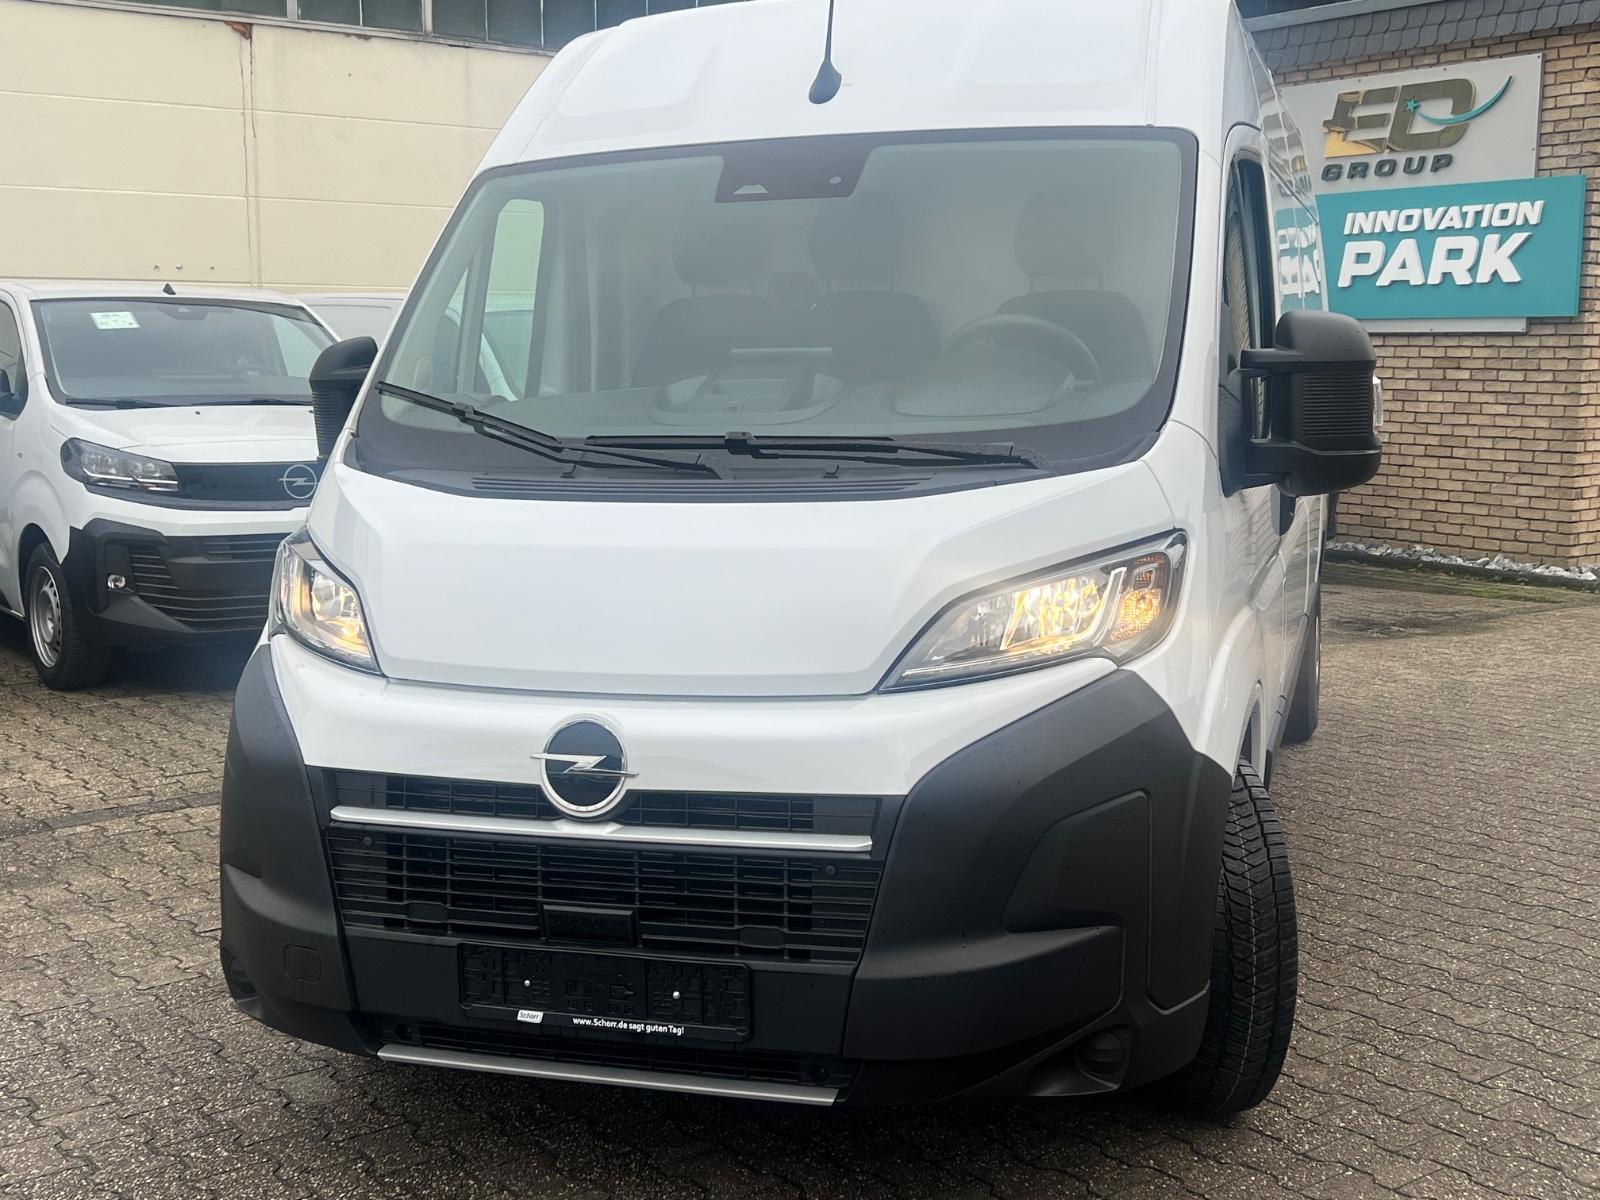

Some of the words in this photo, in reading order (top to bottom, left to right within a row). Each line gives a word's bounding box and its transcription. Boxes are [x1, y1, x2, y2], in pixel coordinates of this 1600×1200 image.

[1321, 153, 1453, 182] GROUP
[1343, 200, 1545, 235] INNOVATION
[1337, 232, 1532, 288] PARK
[519, 1011, 540, 1020] Schorr
[573, 1018, 628, 1029] www.Schorr.de
[628, 1023, 645, 1033] sagt
[645, 1024, 668, 1033] guten
[668, 1025, 685, 1036] Tag!
